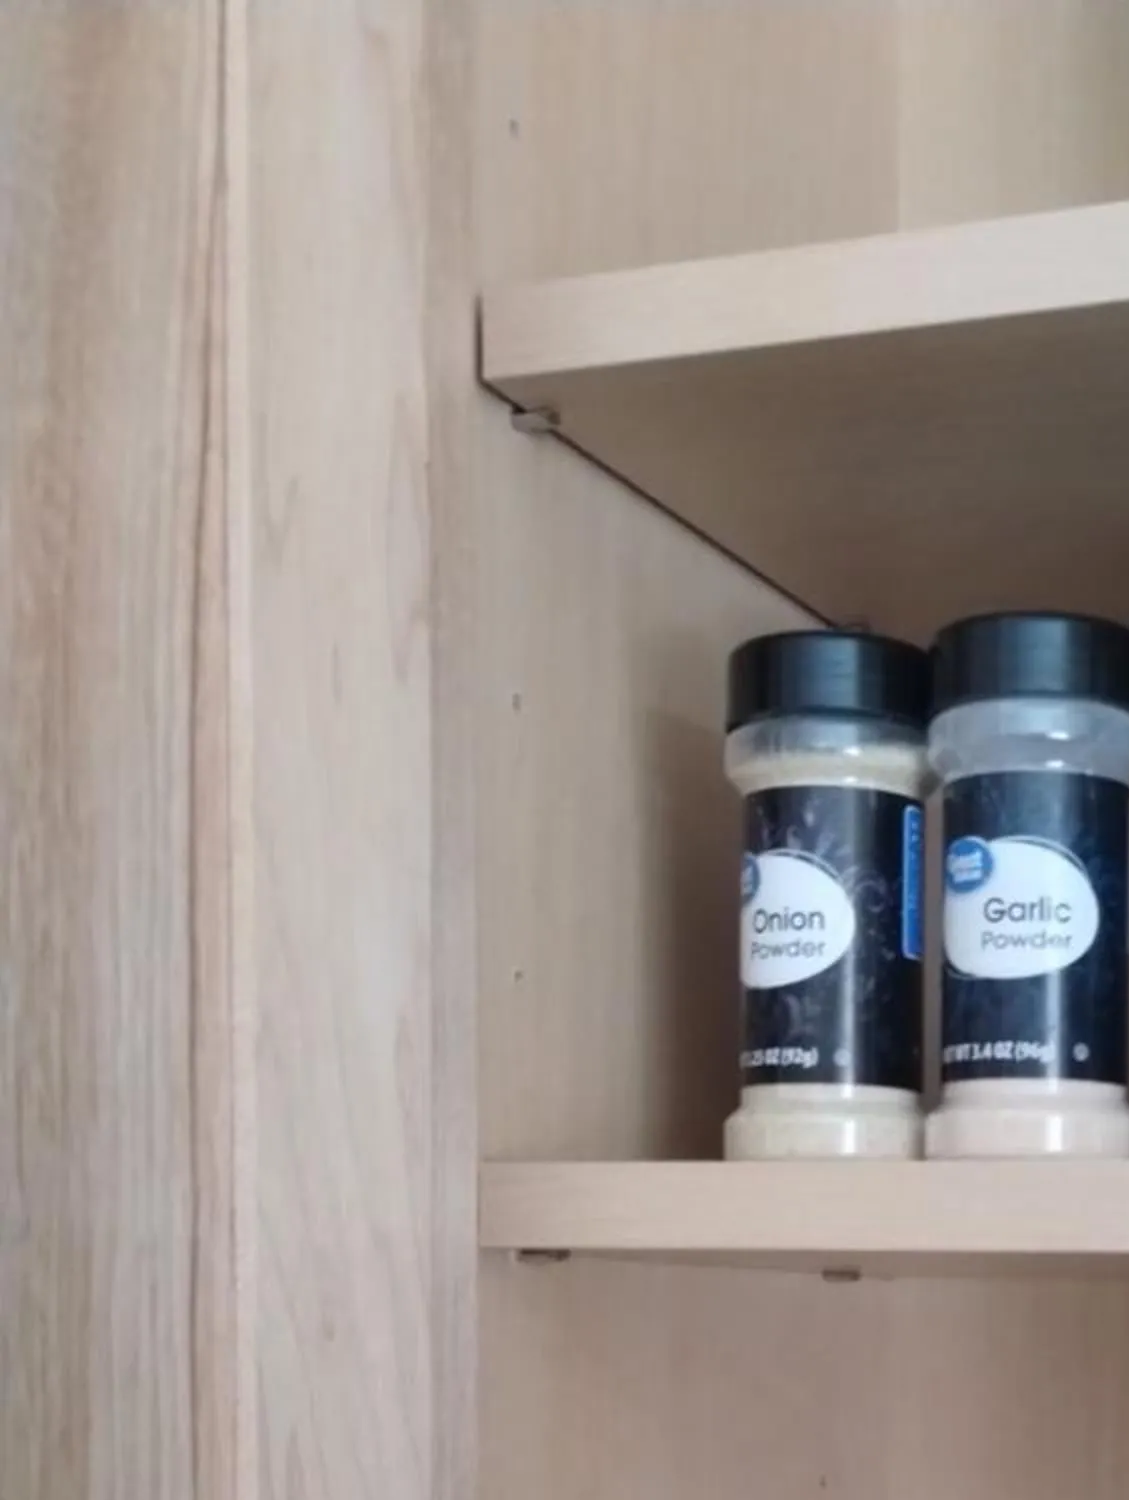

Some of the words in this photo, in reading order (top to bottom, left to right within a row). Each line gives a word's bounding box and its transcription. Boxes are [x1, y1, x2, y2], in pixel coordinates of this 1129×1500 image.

[753, 908, 825, 934] Onion
[984, 897, 1072, 923] Garlic
[750, 940, 826, 960] Powder
[981, 931, 1073, 951] Powder
